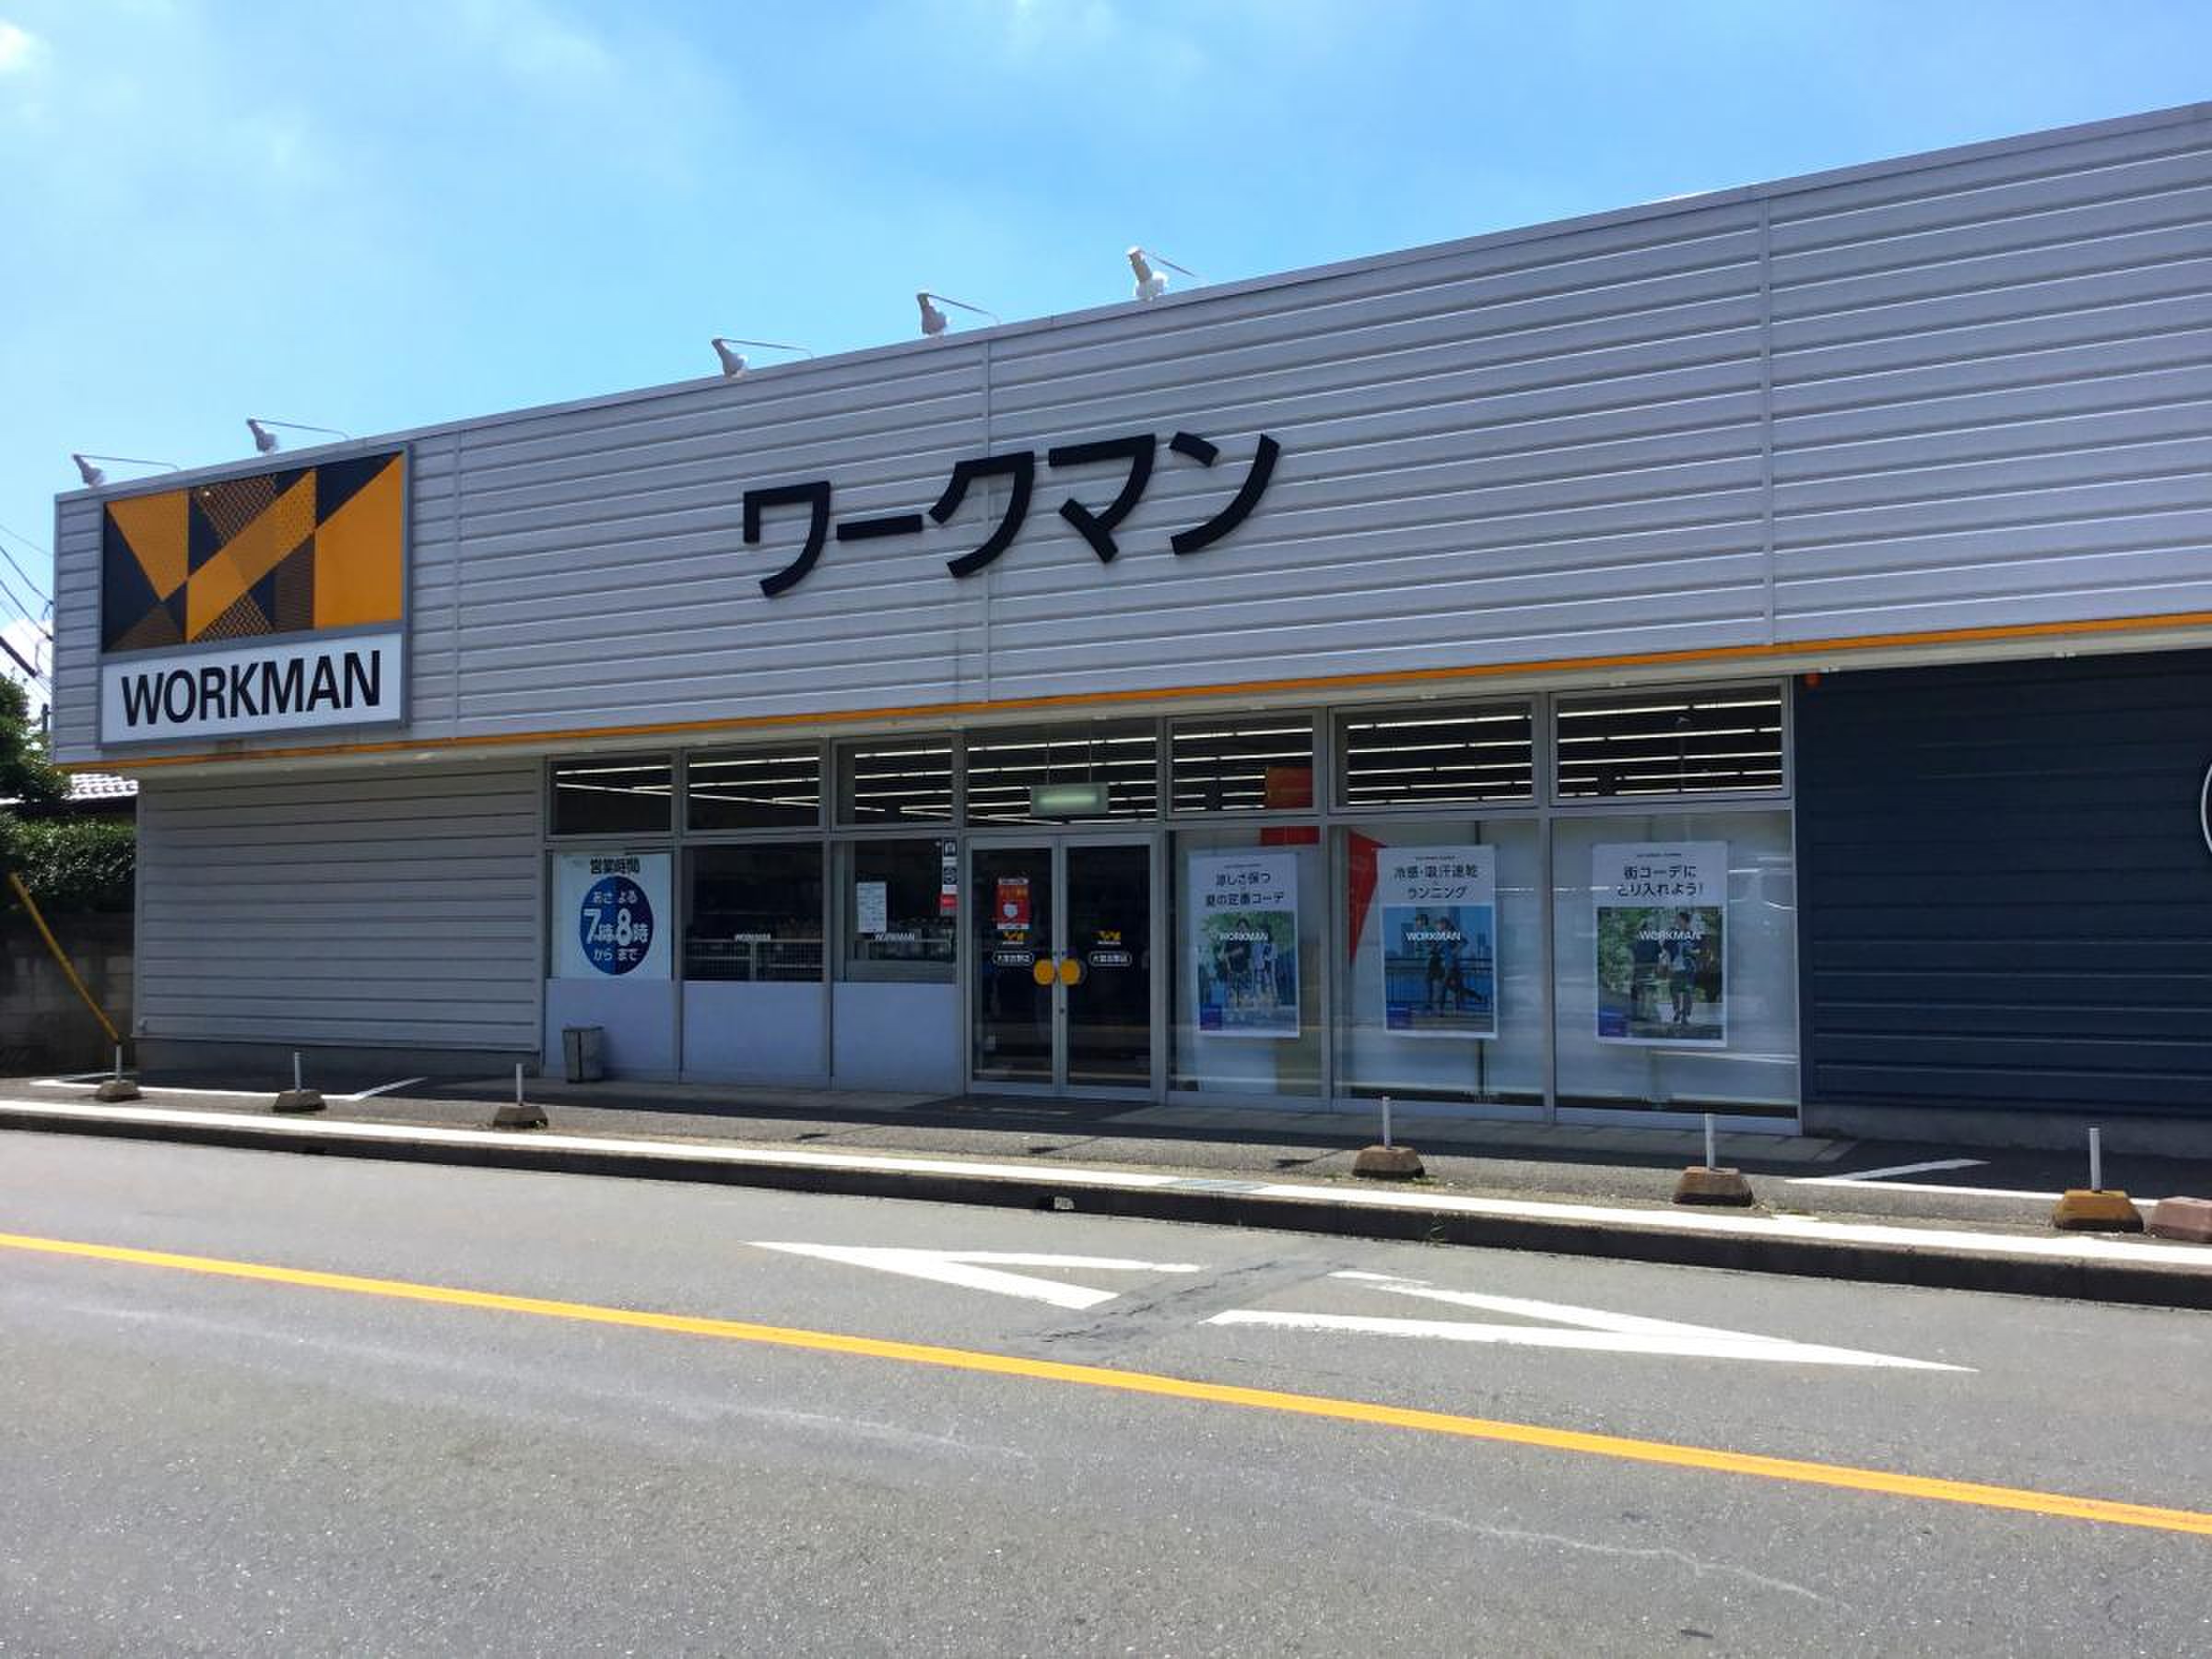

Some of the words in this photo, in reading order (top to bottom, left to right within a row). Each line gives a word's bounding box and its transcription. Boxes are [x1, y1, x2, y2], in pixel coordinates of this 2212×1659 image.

[743, 431, 1280, 597] ワークマン
[122, 650, 381, 726] WORKMAN
[1406, 931, 1460, 941] WORKMAN
[1639, 930, 1700, 940] WORKMAN
